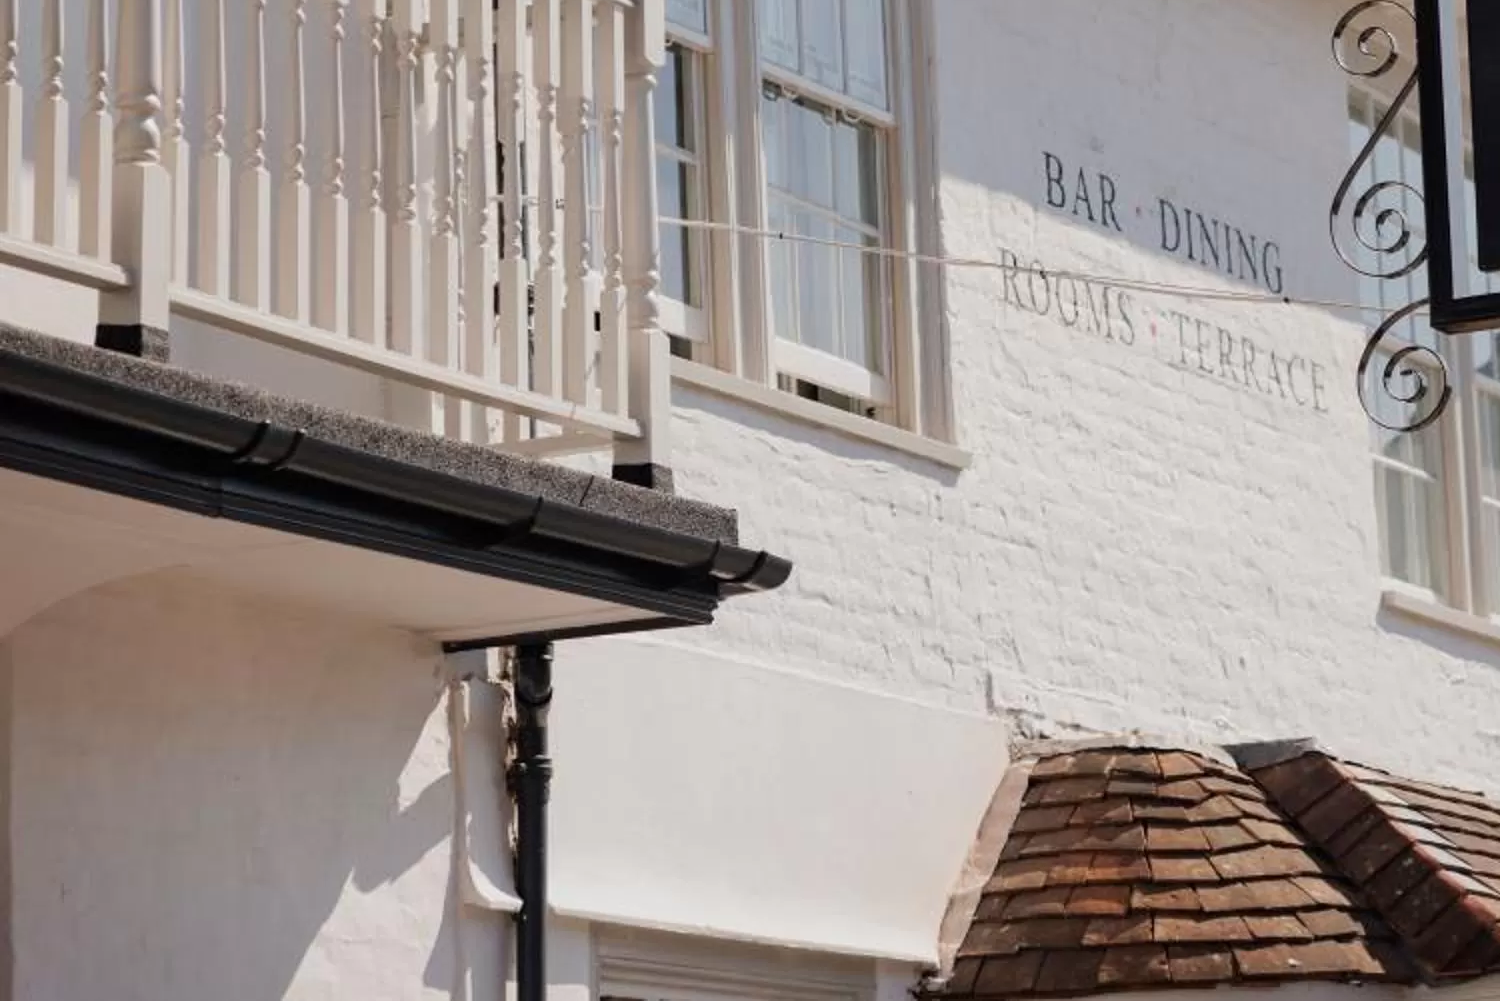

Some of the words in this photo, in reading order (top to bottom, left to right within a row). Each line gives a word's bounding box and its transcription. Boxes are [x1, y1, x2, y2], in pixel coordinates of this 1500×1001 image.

[1042, 151, 1122, 232] BAR
[1159, 198, 1283, 294] DINING
[998, 246, 1135, 345] ROOMS
[1168, 309, 1329, 414] TERRACE
